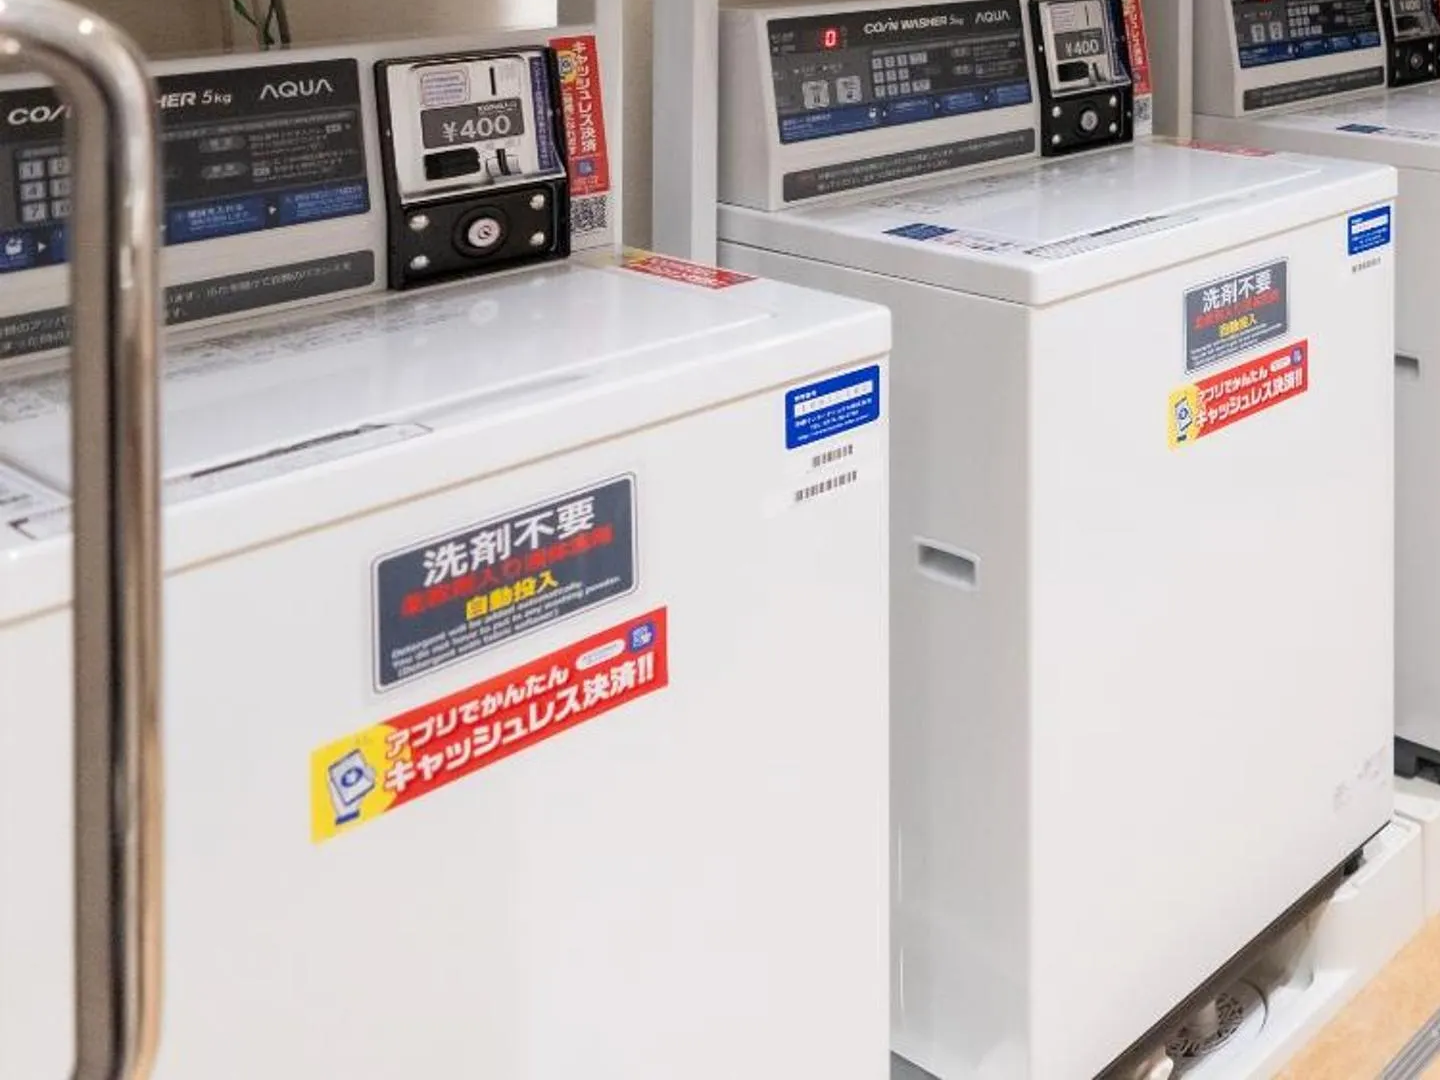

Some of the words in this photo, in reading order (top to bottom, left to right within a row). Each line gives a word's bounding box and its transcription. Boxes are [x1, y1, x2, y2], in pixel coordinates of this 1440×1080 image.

[825, 29, 837, 48] 0
[975, 9, 1011, 25] AQUA
[260, 78, 334, 100] AQUA
[441, 115, 512, 143] ¥400
[1202, 269, 1273, 313] 洗剤不要
[422, 496, 596, 588] 洗剤不要
[466, 570, 559, 622] 自動投入
[384, 651, 655, 792] キャッシュレス決済!!
[386, 665, 570, 759] アプリでかんたん
